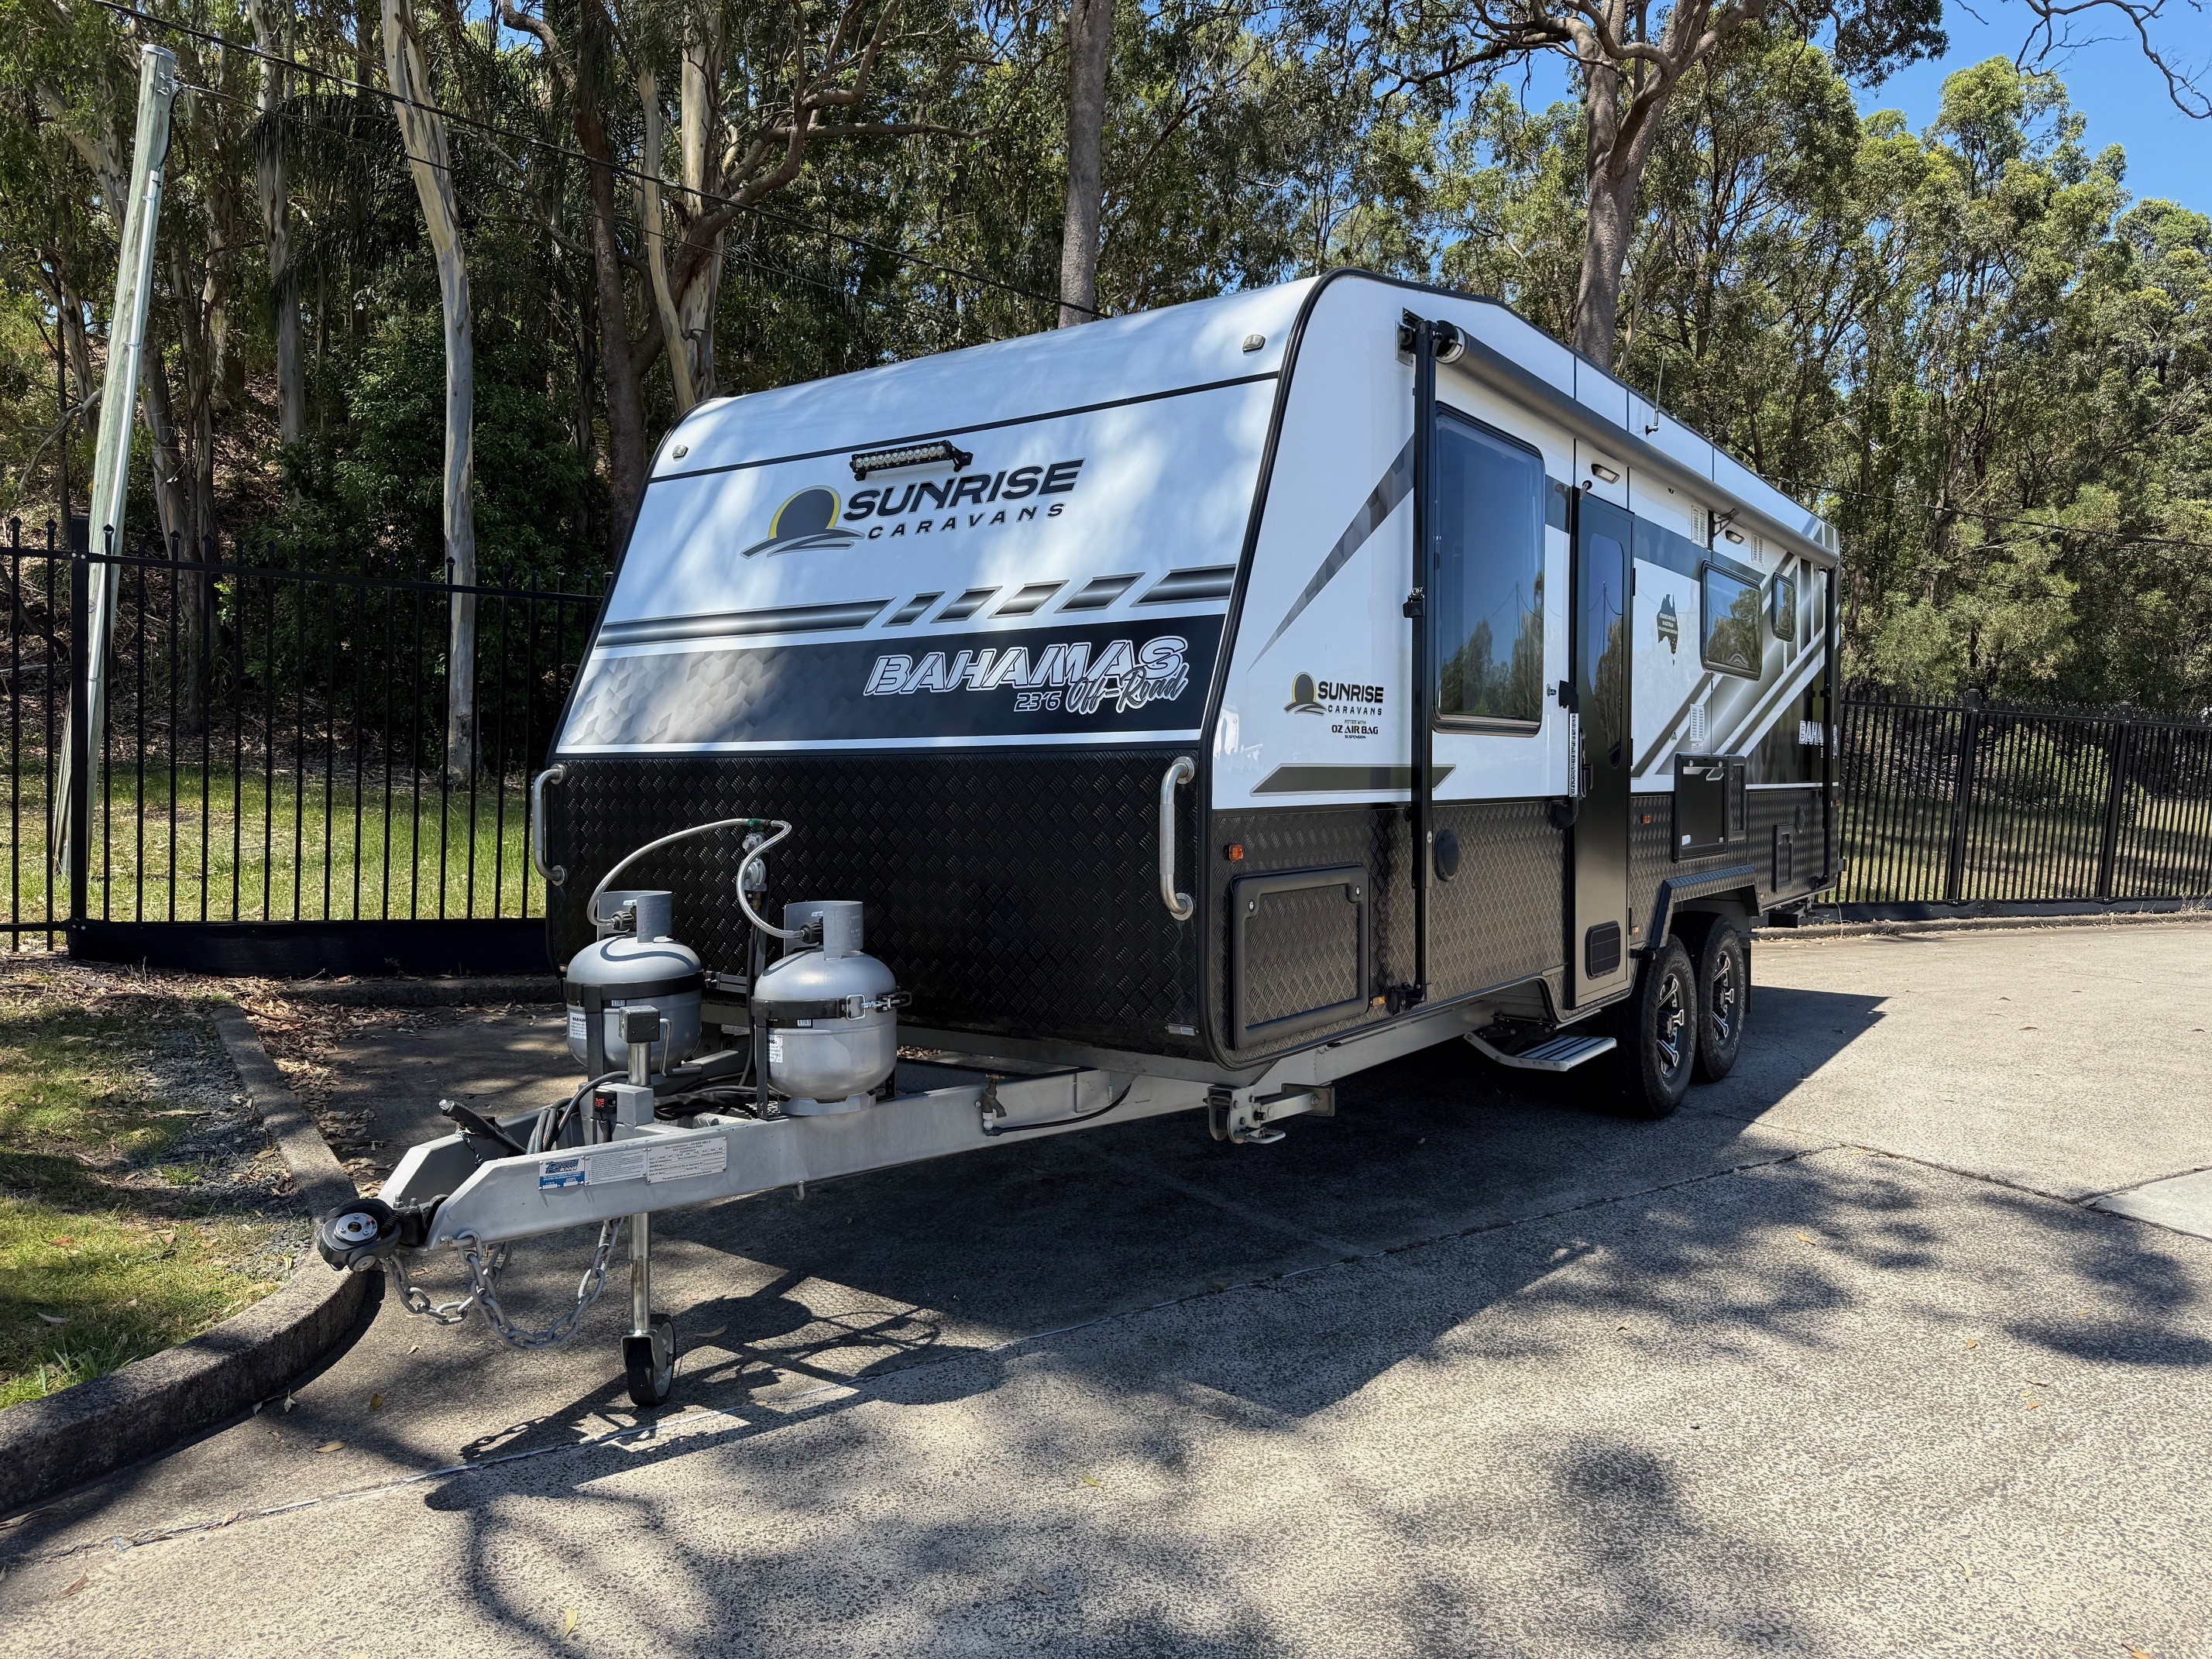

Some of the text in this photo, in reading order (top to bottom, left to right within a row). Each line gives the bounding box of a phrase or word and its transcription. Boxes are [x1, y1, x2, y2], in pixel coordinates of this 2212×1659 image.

[843, 458, 1086, 522] SUNRISE
[867, 501, 1066, 540] CARAVANS
[864, 635, 1190, 696] BAHAMAS
[1065, 662, 1190, 715] Off-Road
[1317, 681, 1384, 704] SUNRISE
[1328, 704, 1382, 716] CARAVANS
[1331, 724, 1379, 734] OZ AIR BAG
